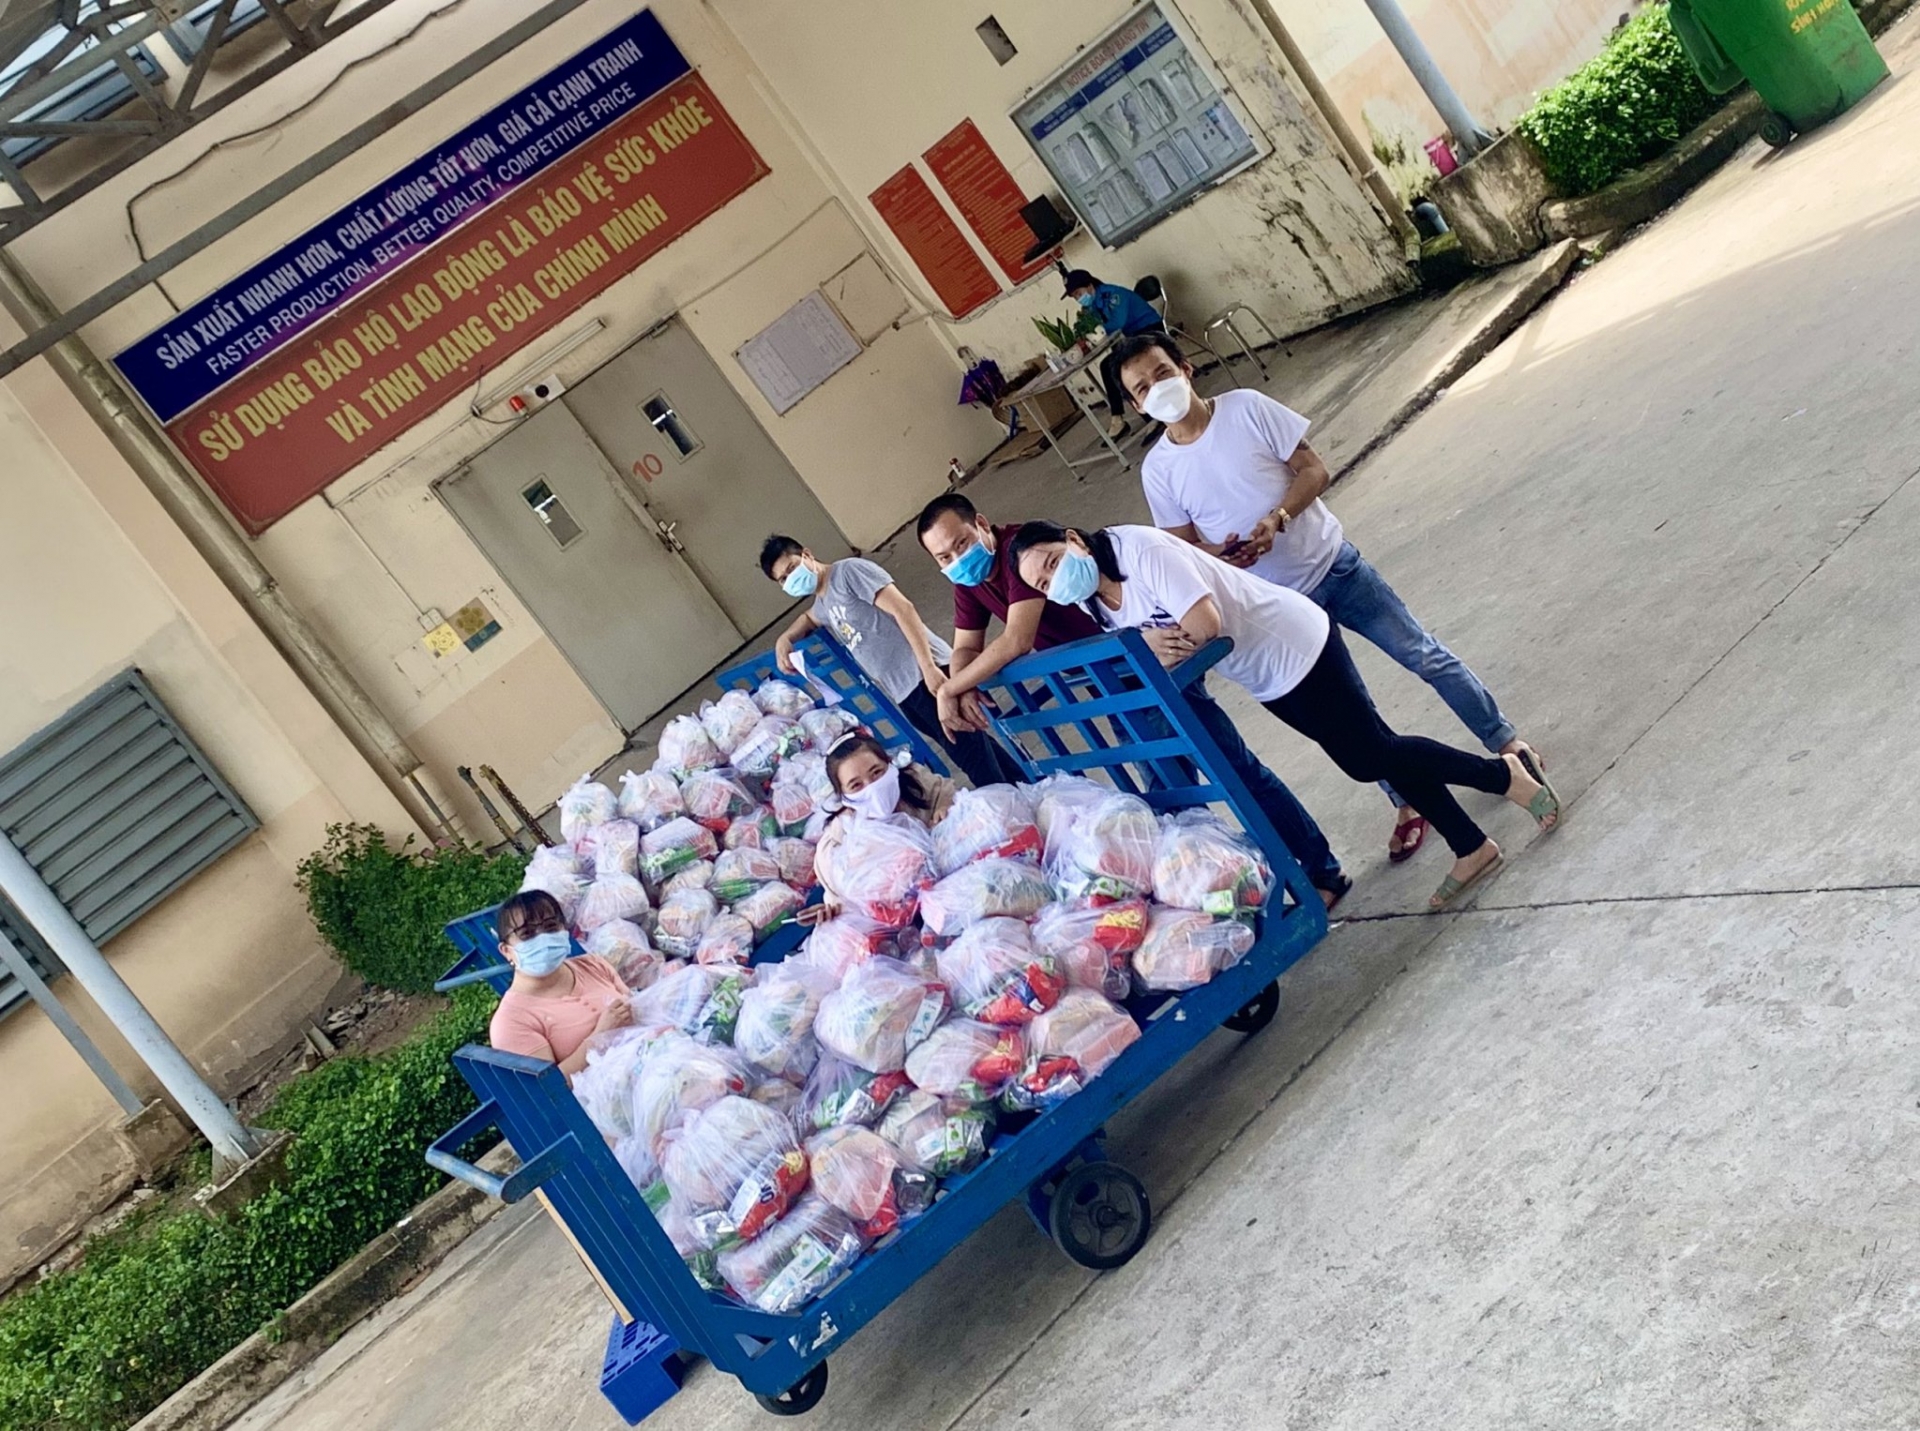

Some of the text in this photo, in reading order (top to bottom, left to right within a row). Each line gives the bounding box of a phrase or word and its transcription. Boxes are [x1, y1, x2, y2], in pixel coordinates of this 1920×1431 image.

[156, 38, 642, 368] SẢN XUẤT NHANH HƠN, CHẤT LƯỢNG TỐT HƠN, GIÁ CẢ CẠNH TRANH
[1066, 65, 1093, 88] NOTICE
[199, 96, 712, 460] SỬ DỤNG BẢO HỘ LAO ĐỘNG LÀ BẢO VỆ SỨC KHỎE
[206, 82, 635, 374] FASTER PRODUCTION, BETTER QUALITY, COMPETITIVE PRICE
[324, 193, 667, 443] VÀ TÍNH MẠNG CỦA CHÍNH MÌNH
[633, 454, 662, 482] 10
